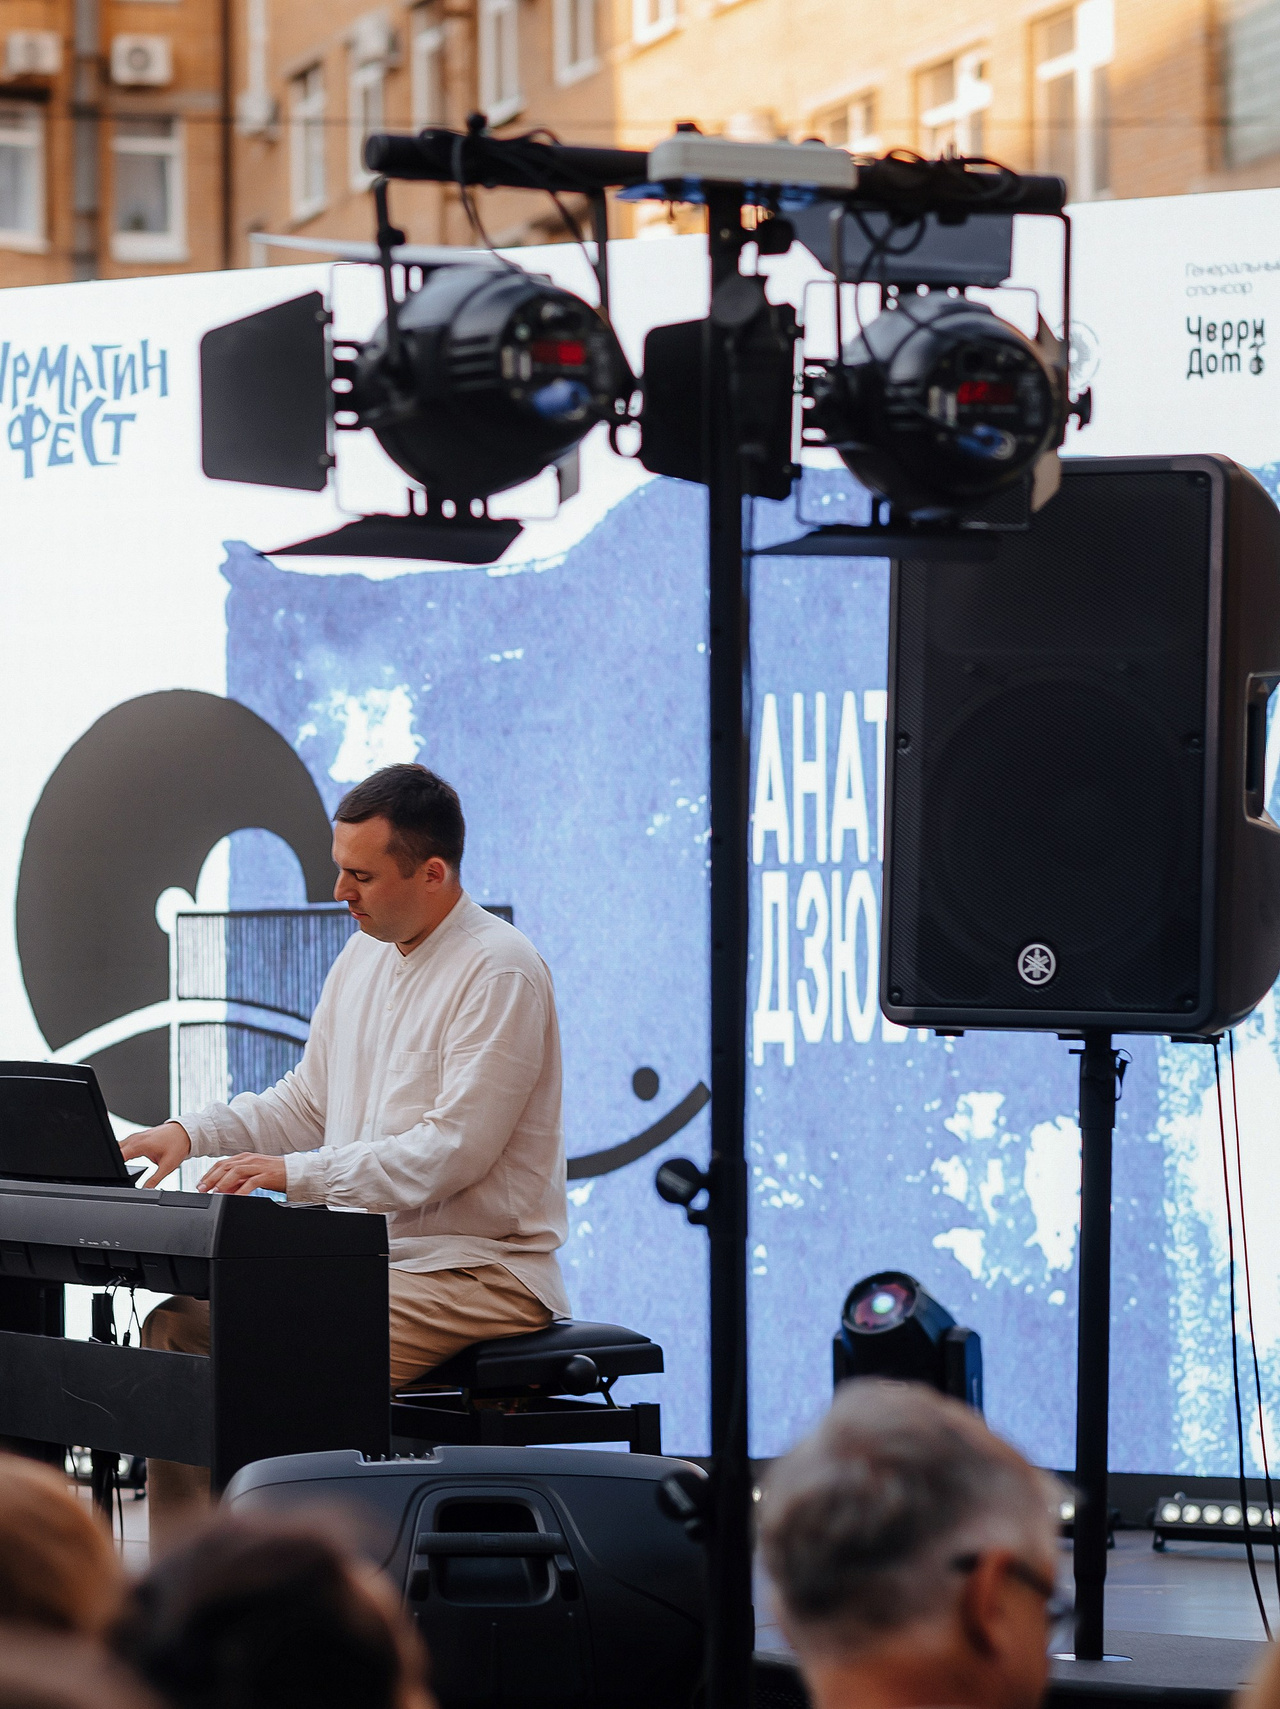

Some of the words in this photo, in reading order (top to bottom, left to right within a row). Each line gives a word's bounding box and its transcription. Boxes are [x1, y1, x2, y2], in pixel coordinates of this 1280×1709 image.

[7, 396, 137, 480] ФЕСТ
[752, 690, 888, 864] АНАТ
[752, 869, 956, 1066] ДЗЮ
